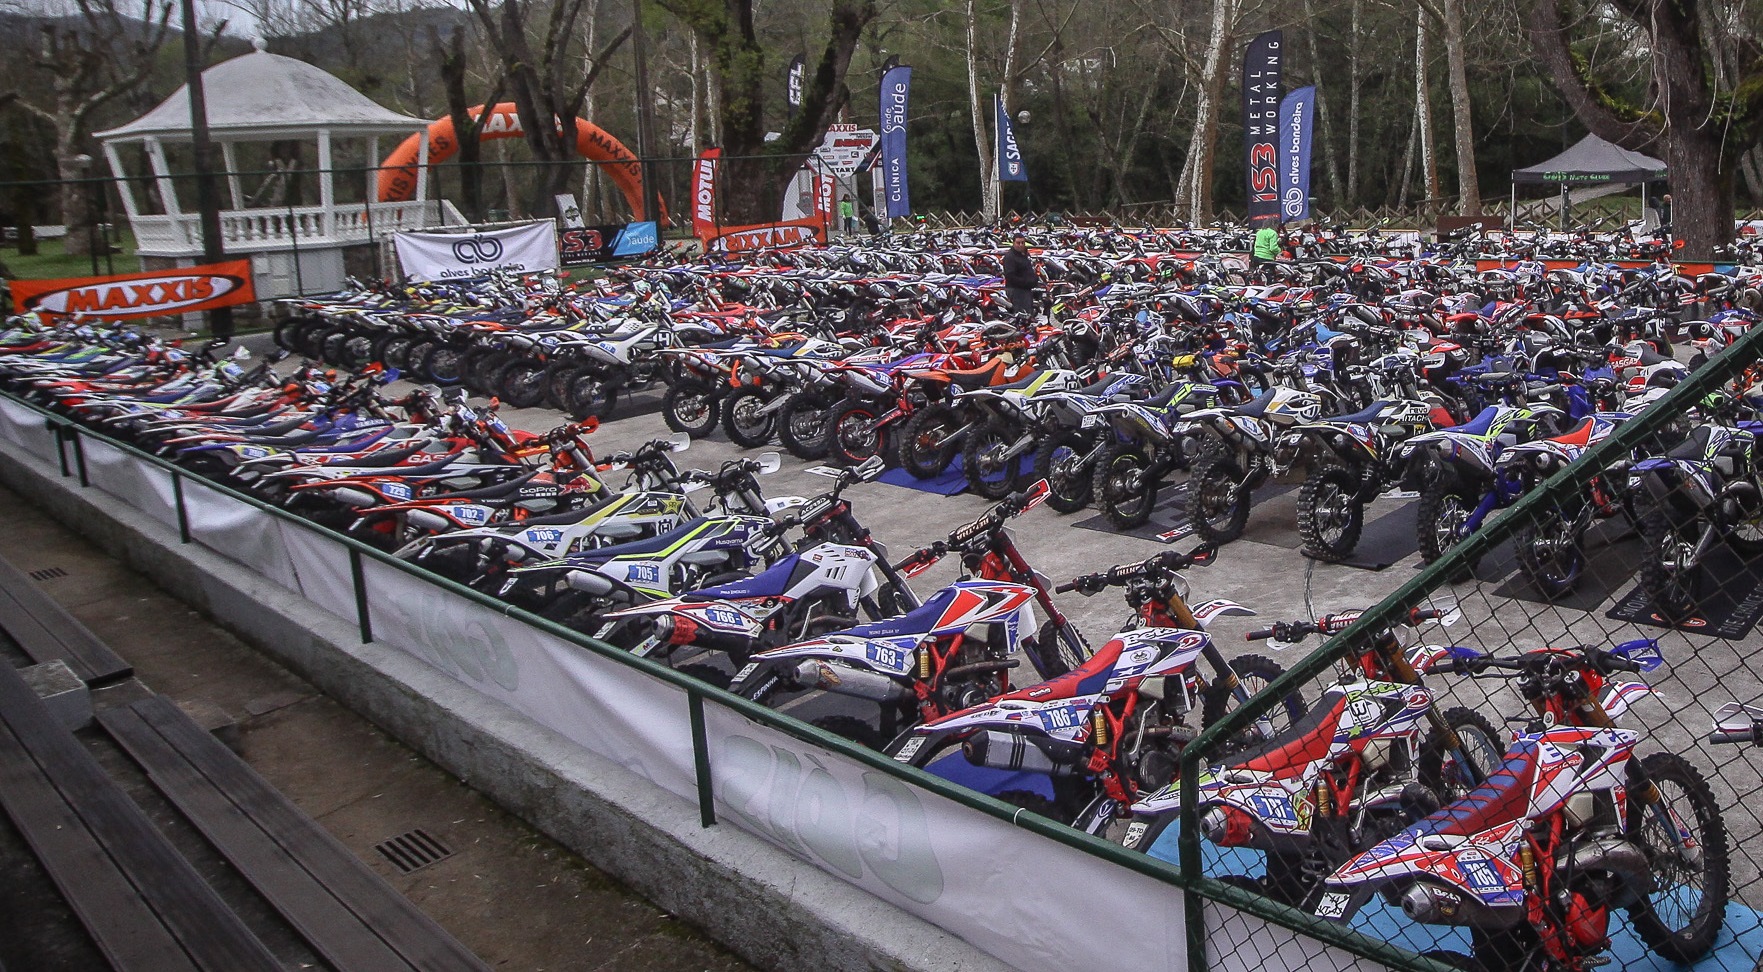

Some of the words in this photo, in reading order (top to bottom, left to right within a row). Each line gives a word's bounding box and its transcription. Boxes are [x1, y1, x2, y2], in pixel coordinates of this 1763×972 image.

[1265, 41, 1280, 135] WORKING
[1250, 70, 1262, 135] METAL
[829, 124, 856, 133] AXXIS
[1289, 101, 1304, 153] bandeira
[1290, 155, 1301, 185] alves
[891, 157, 902, 202] CLÍNICA
[440, 268, 471, 278] alves
[65, 276, 215, 313] MAXXIS
[519, 486, 558, 494] GoPro
[460, 507, 478, 519] 702
[534, 530, 555, 541] 706
[715, 538, 744, 547] Husqvarna
[635, 566, 654, 581] 705
[712, 610, 736, 624] 766
[874, 645, 897, 666] 763
[1046, 708, 1071, 728] 786
